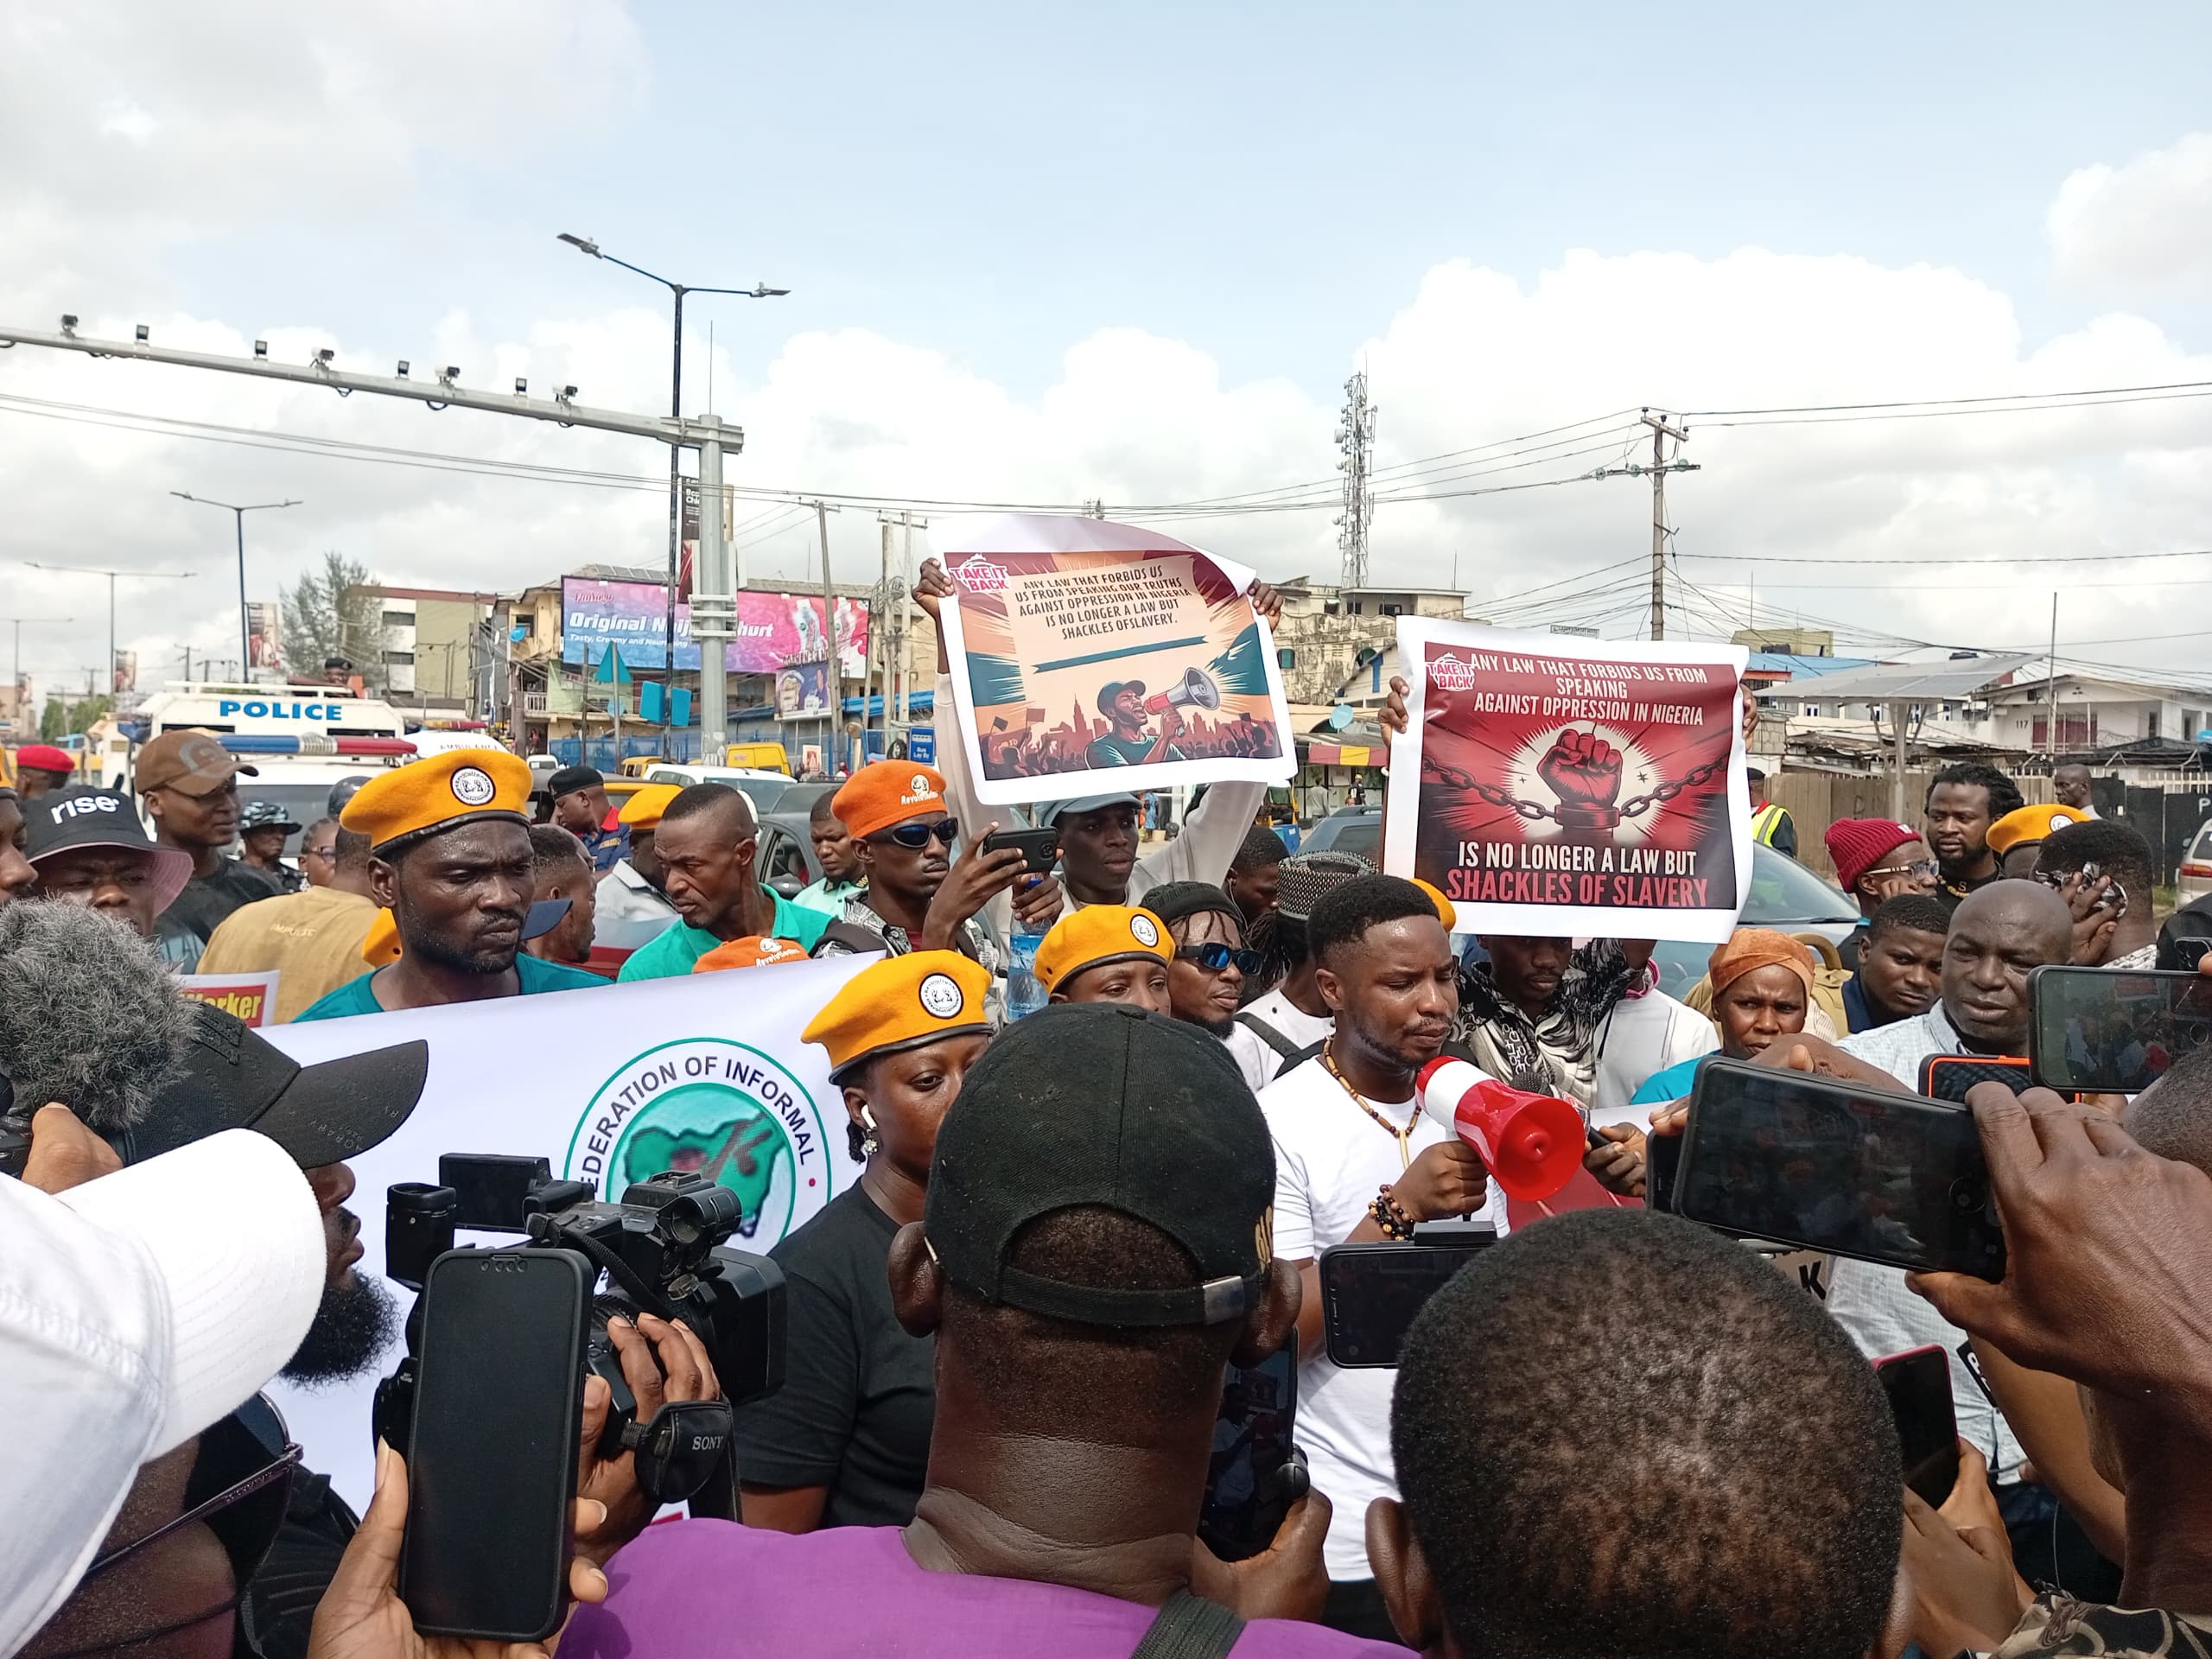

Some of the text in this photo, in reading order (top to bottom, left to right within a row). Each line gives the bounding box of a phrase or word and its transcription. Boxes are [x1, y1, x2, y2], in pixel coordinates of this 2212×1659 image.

[952, 567, 1007, 580] TAKE IT
[1024, 565, 1163, 589] ANY LAW THAT FORBIDS US
[968, 580, 1009, 591] BACK
[1015, 577, 1183, 602] US FROM SPEAKING OUR TRUTHS
[1020, 588, 1192, 616] AGAINST OPPRESSION IN NIGERIA
[1046, 599, 1180, 627] IS NO LONGER A LAW BUT
[569, 612, 647, 632] Original
[652, 617, 691, 636] Nij
[1062, 620, 1114, 640] SHACKLES
[570, 633, 594, 644] Tasty,
[1427, 663, 1471, 675] TAKE IT
[1471, 652, 1708, 684] ANY LAW THAT FORBIDS US FROM
[1439, 675, 1471, 688] BACK
[1556, 677, 1628, 699] SPEAKING
[219, 700, 343, 721] POLICE
[1474, 692, 1704, 726] AGAINST OPPRESSION IN NIGERIA
[2016, 720, 2029, 729] 117
[1458, 841, 1698, 876] IS NO LONGER A LAW BUT
[1446, 869, 1708, 907] SHACKLES OF SLAVERY
[580, 1055, 815, 1193] EDERATION OF INFORMAL
[691, 1435, 724, 1451] SONY
